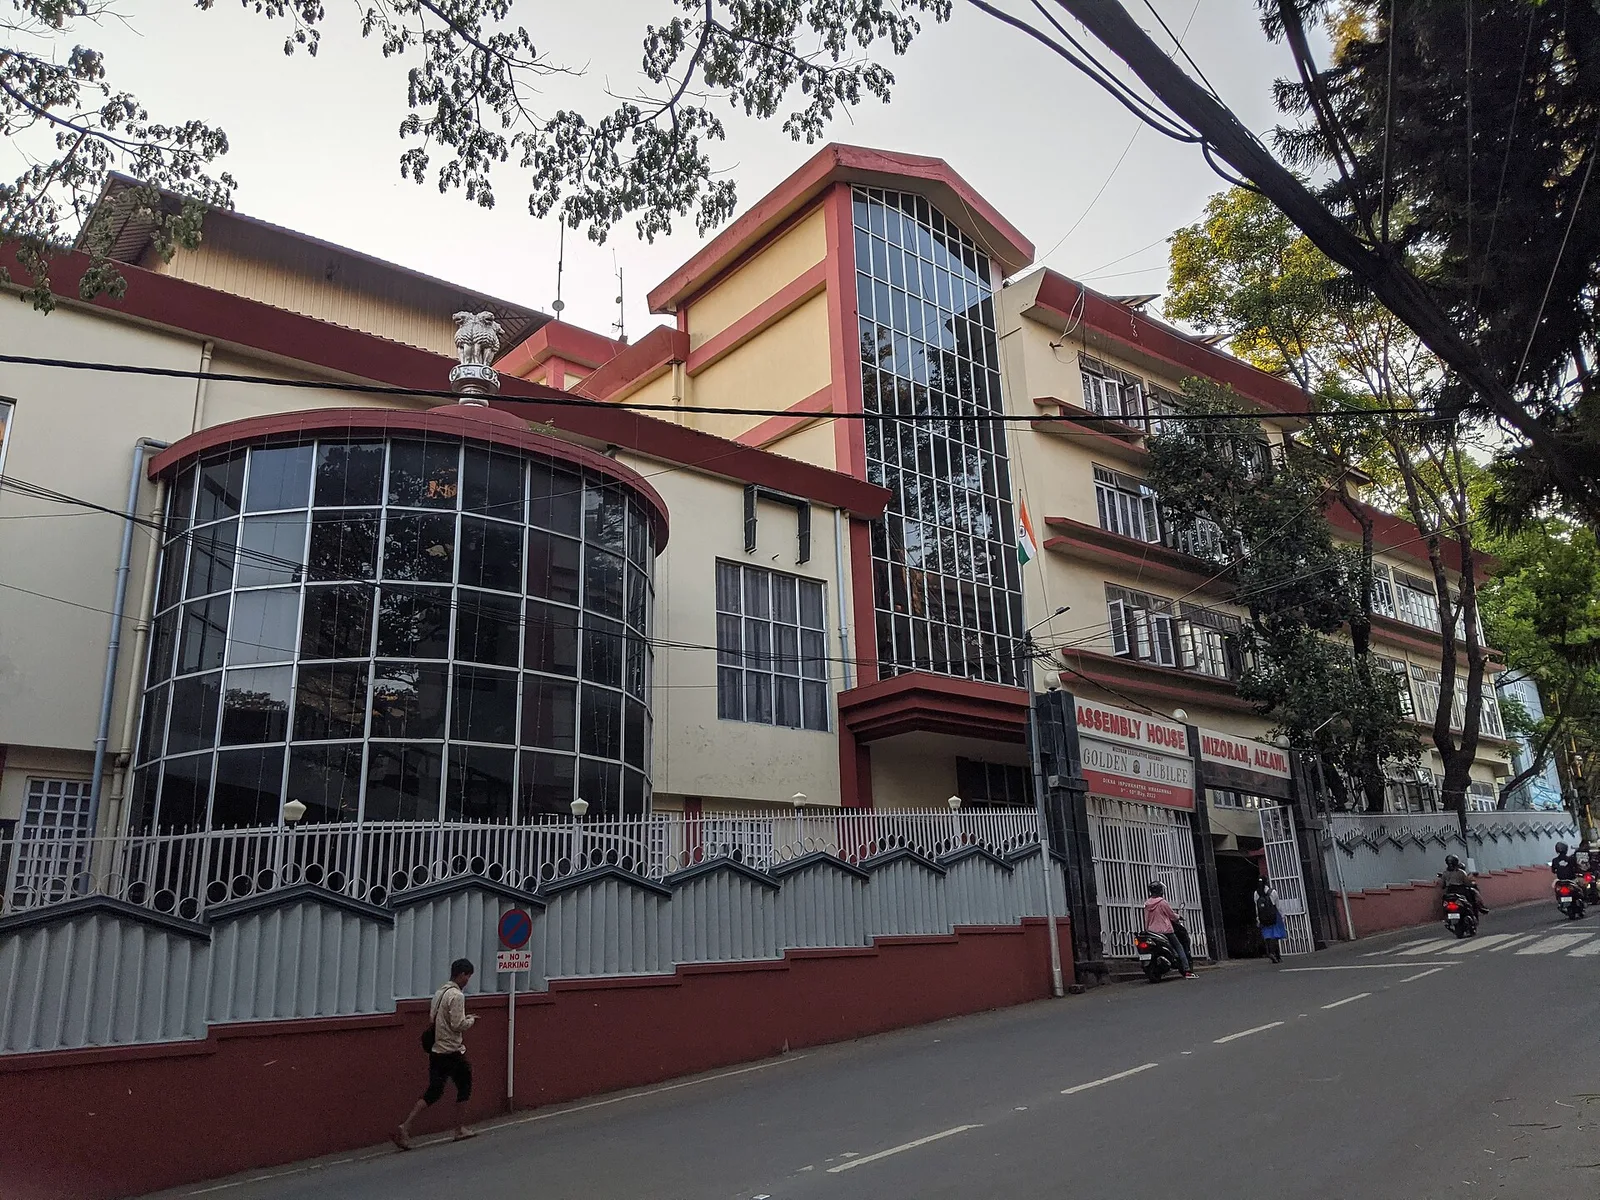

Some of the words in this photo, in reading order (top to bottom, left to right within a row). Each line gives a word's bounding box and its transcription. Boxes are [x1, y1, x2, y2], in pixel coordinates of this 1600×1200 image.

[1077, 705, 1142, 740] ASSEMBLY
[1147, 723, 1186, 750] HOUSE
[1083, 748, 1128, 772] GOLDEN
[1146, 761, 1188, 784] JUBILEE
[1202, 735, 1251, 766] MIZORAM,
[1254, 748, 1288, 773] AIZAWL
